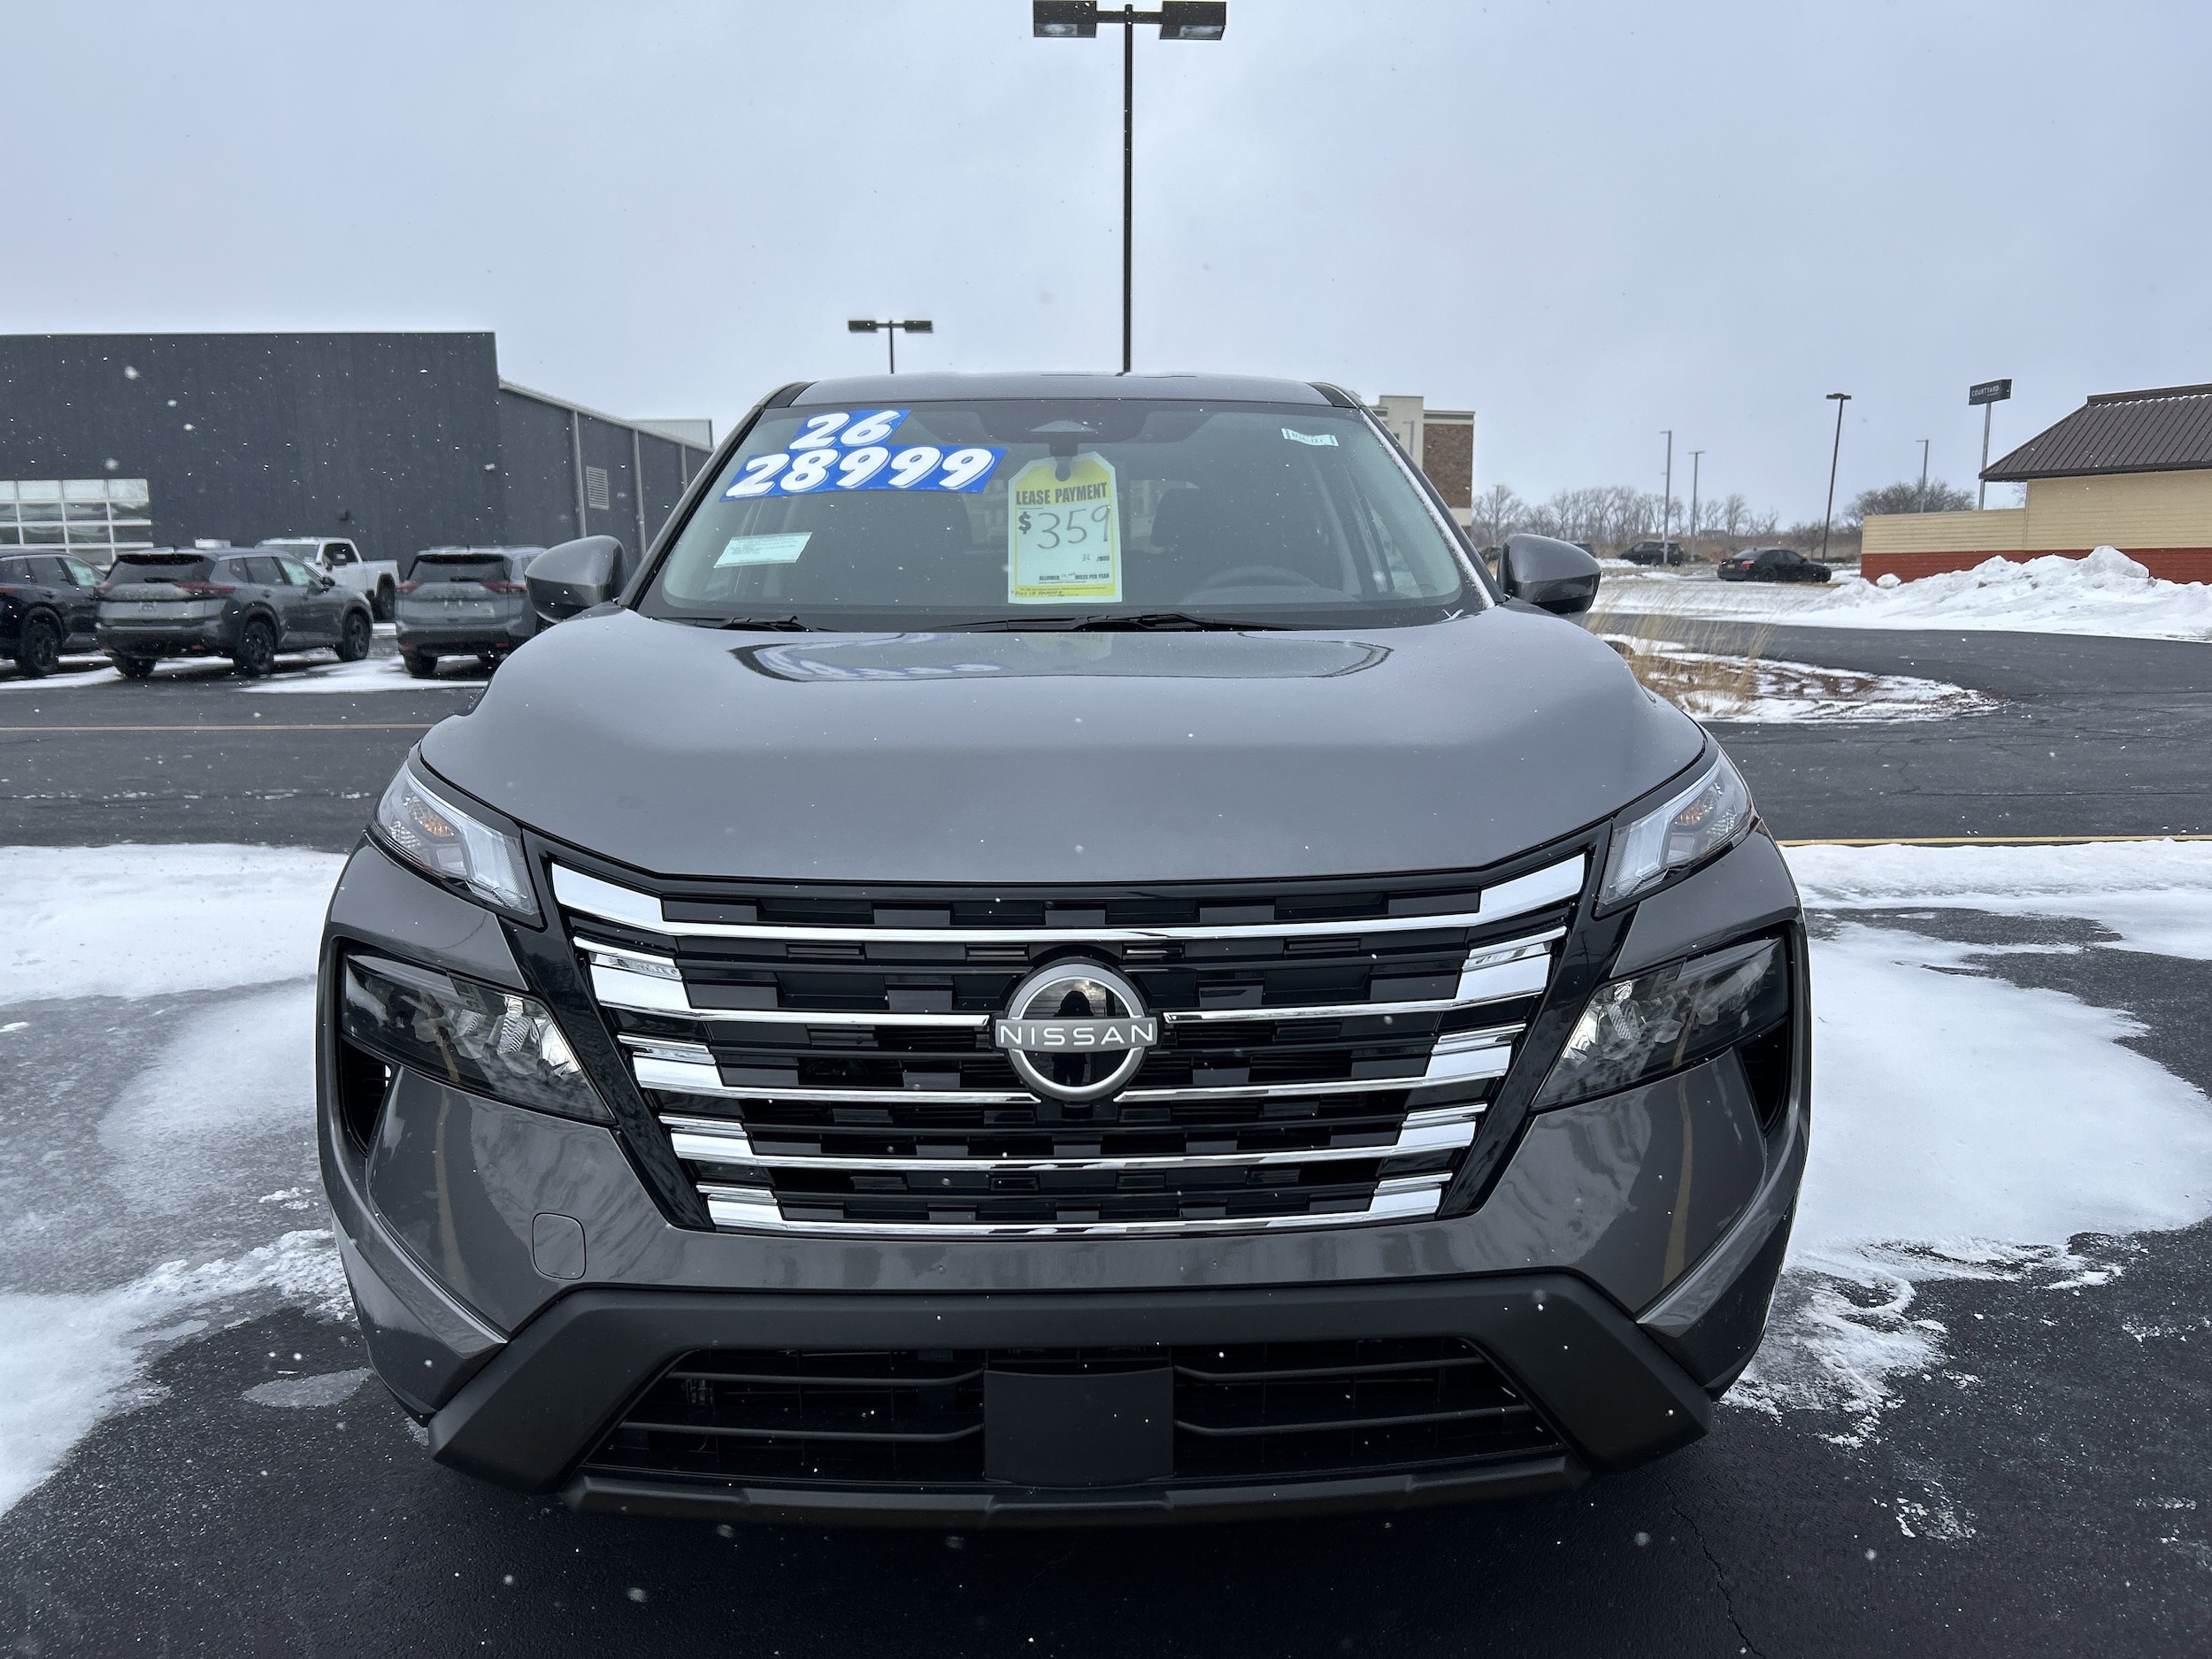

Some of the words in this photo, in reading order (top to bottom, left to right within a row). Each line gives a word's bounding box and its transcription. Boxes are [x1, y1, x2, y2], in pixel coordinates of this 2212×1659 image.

[789, 411, 901, 450] 26
[726, 447, 996, 498] 28999
[1016, 489, 1050, 505] LEASE
[1055, 482, 1107, 503] PAYMENT
[1000, 1023, 1153, 1046] NISSAN
